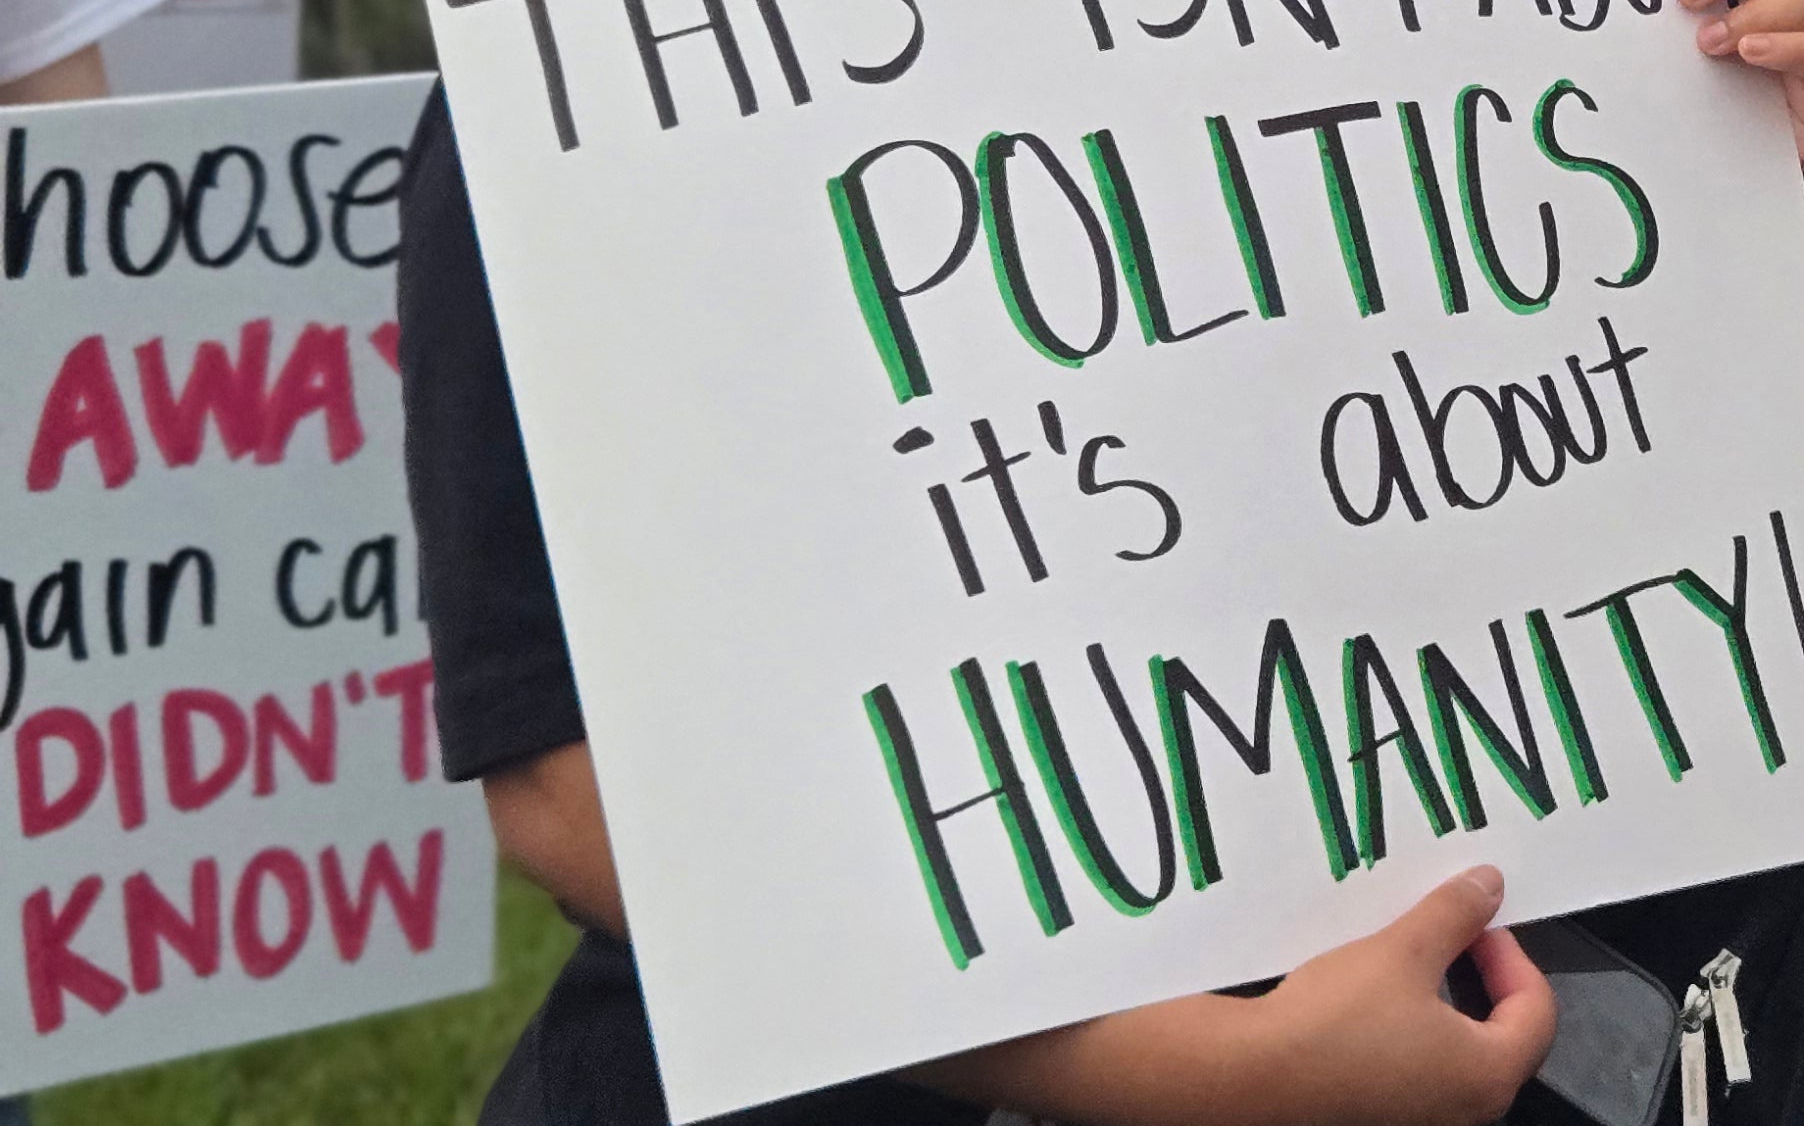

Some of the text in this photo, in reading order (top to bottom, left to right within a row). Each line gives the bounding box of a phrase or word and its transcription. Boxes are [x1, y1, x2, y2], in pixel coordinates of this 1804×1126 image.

[2, 128, 402, 276] hoose
[825, 79, 1657, 402] POLITICS
[892, 317, 1649, 596] it's about
[275, 534, 430, 637] ca
[15, 657, 436, 839] DIDN'T
[22, 829, 443, 1034] KNOW
